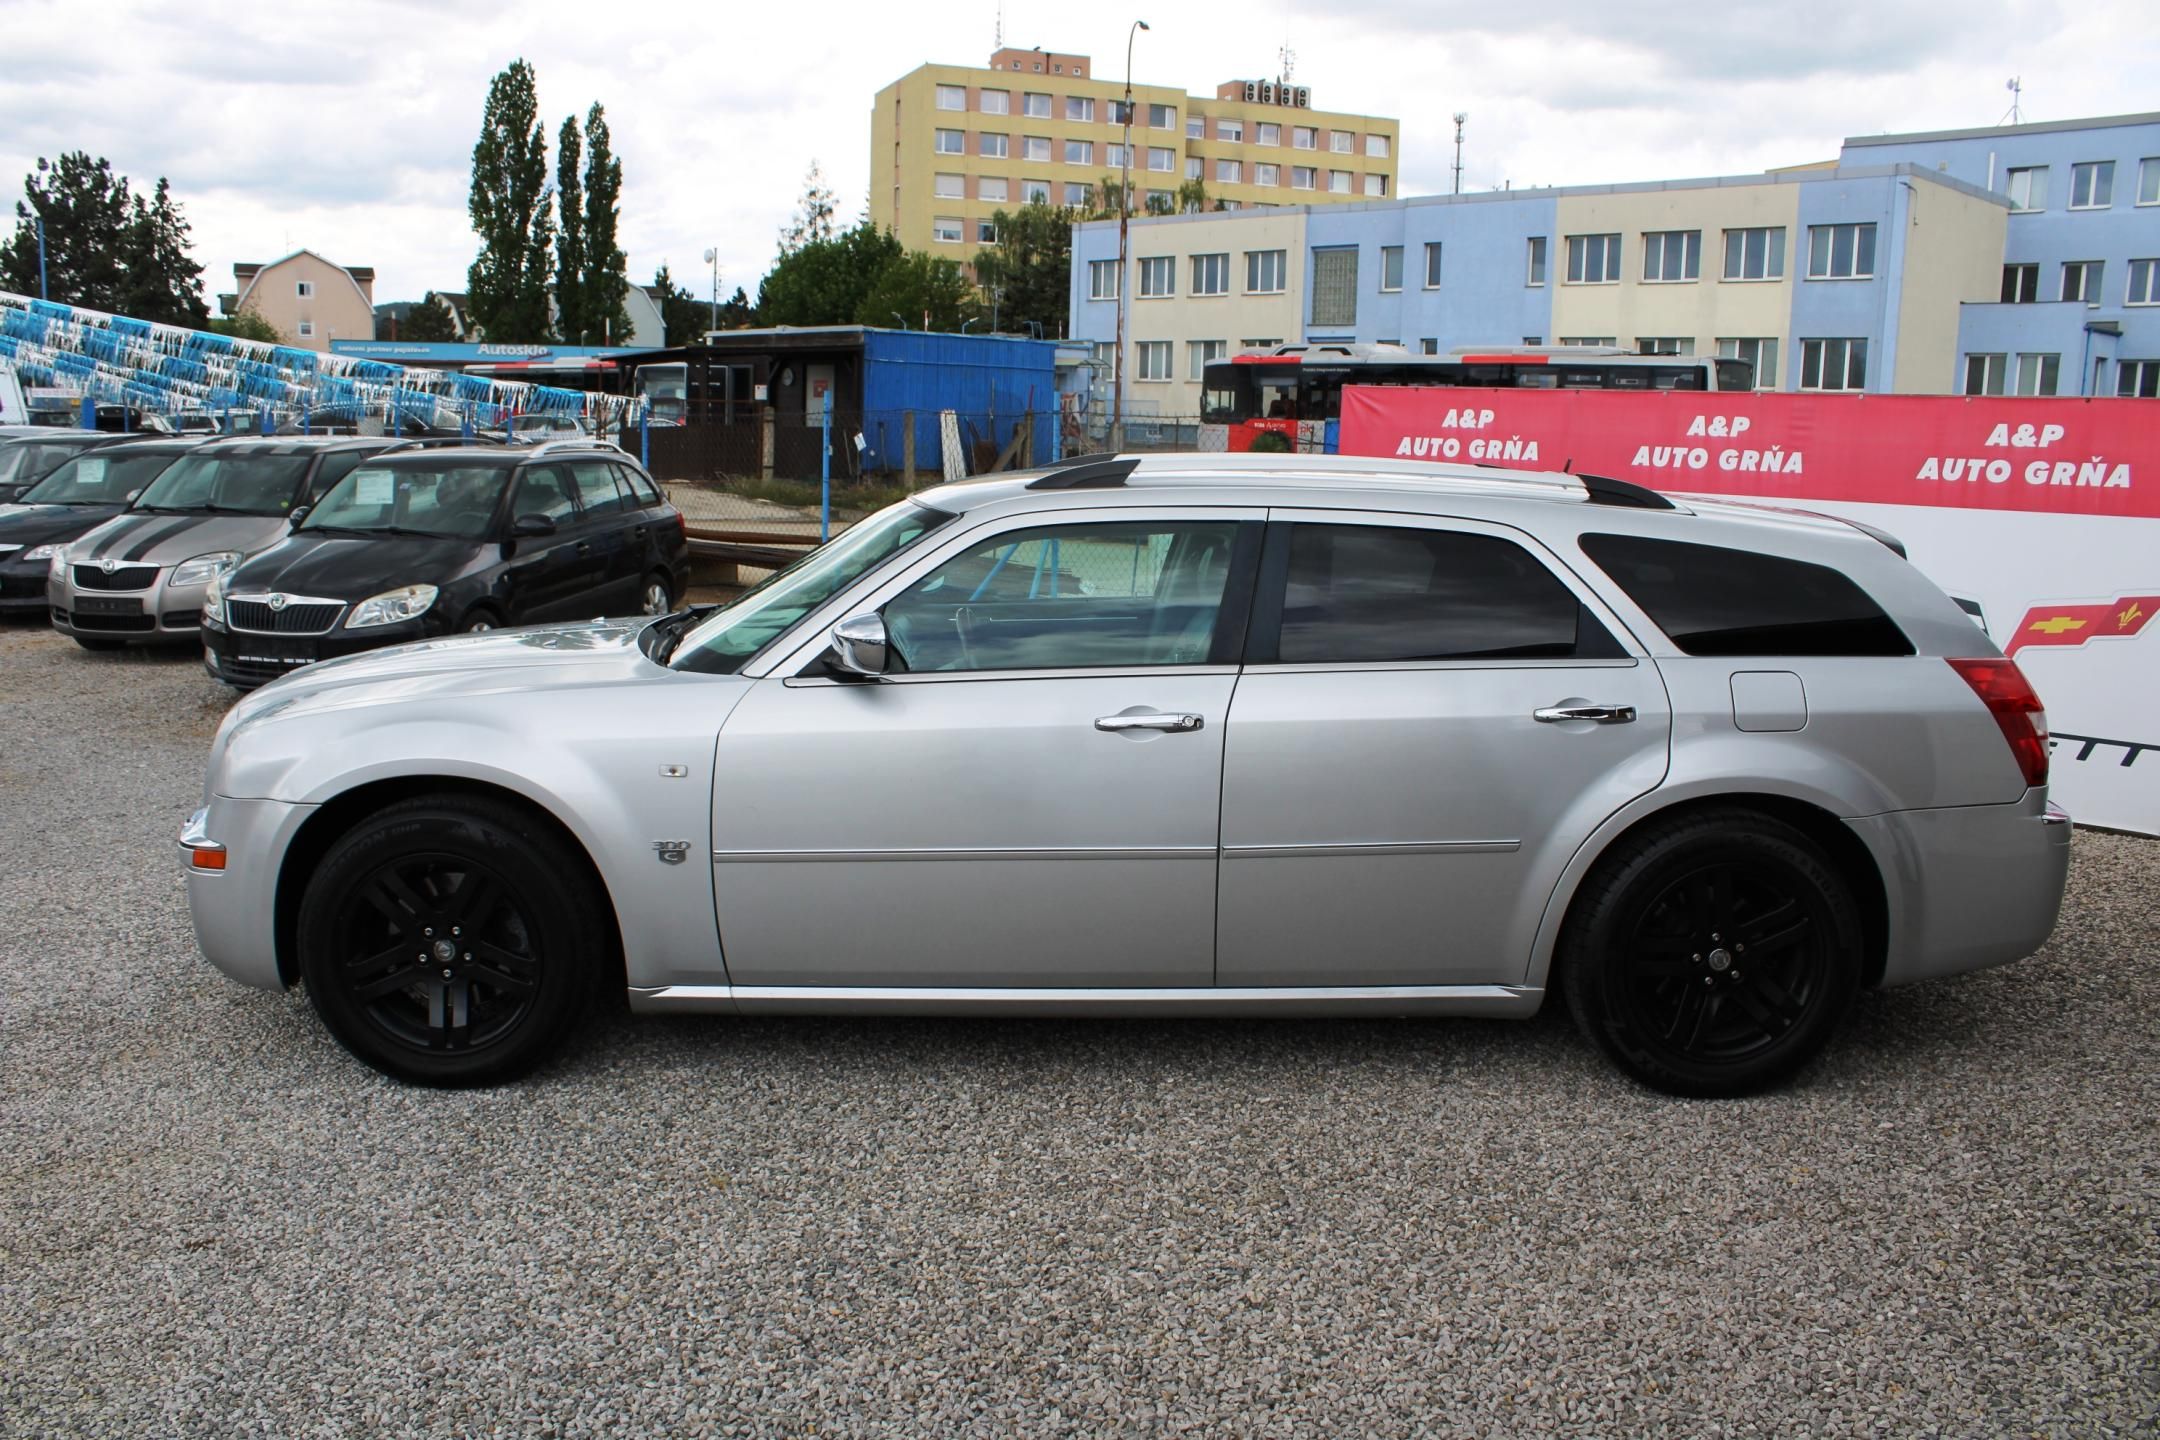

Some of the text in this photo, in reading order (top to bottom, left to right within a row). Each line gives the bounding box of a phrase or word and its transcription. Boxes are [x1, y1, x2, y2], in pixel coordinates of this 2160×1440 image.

[477, 343, 548, 356] Autosklo
[1441, 408, 1495, 429] A&P
[1686, 415, 1750, 437] A&P
[1396, 435, 1539, 461] AUTO GRŇA
[1984, 423, 2064, 448] A&P
[1631, 445, 1803, 474] AUTO GRŇA
[1916, 456, 2131, 488] AUTO GRŇA
